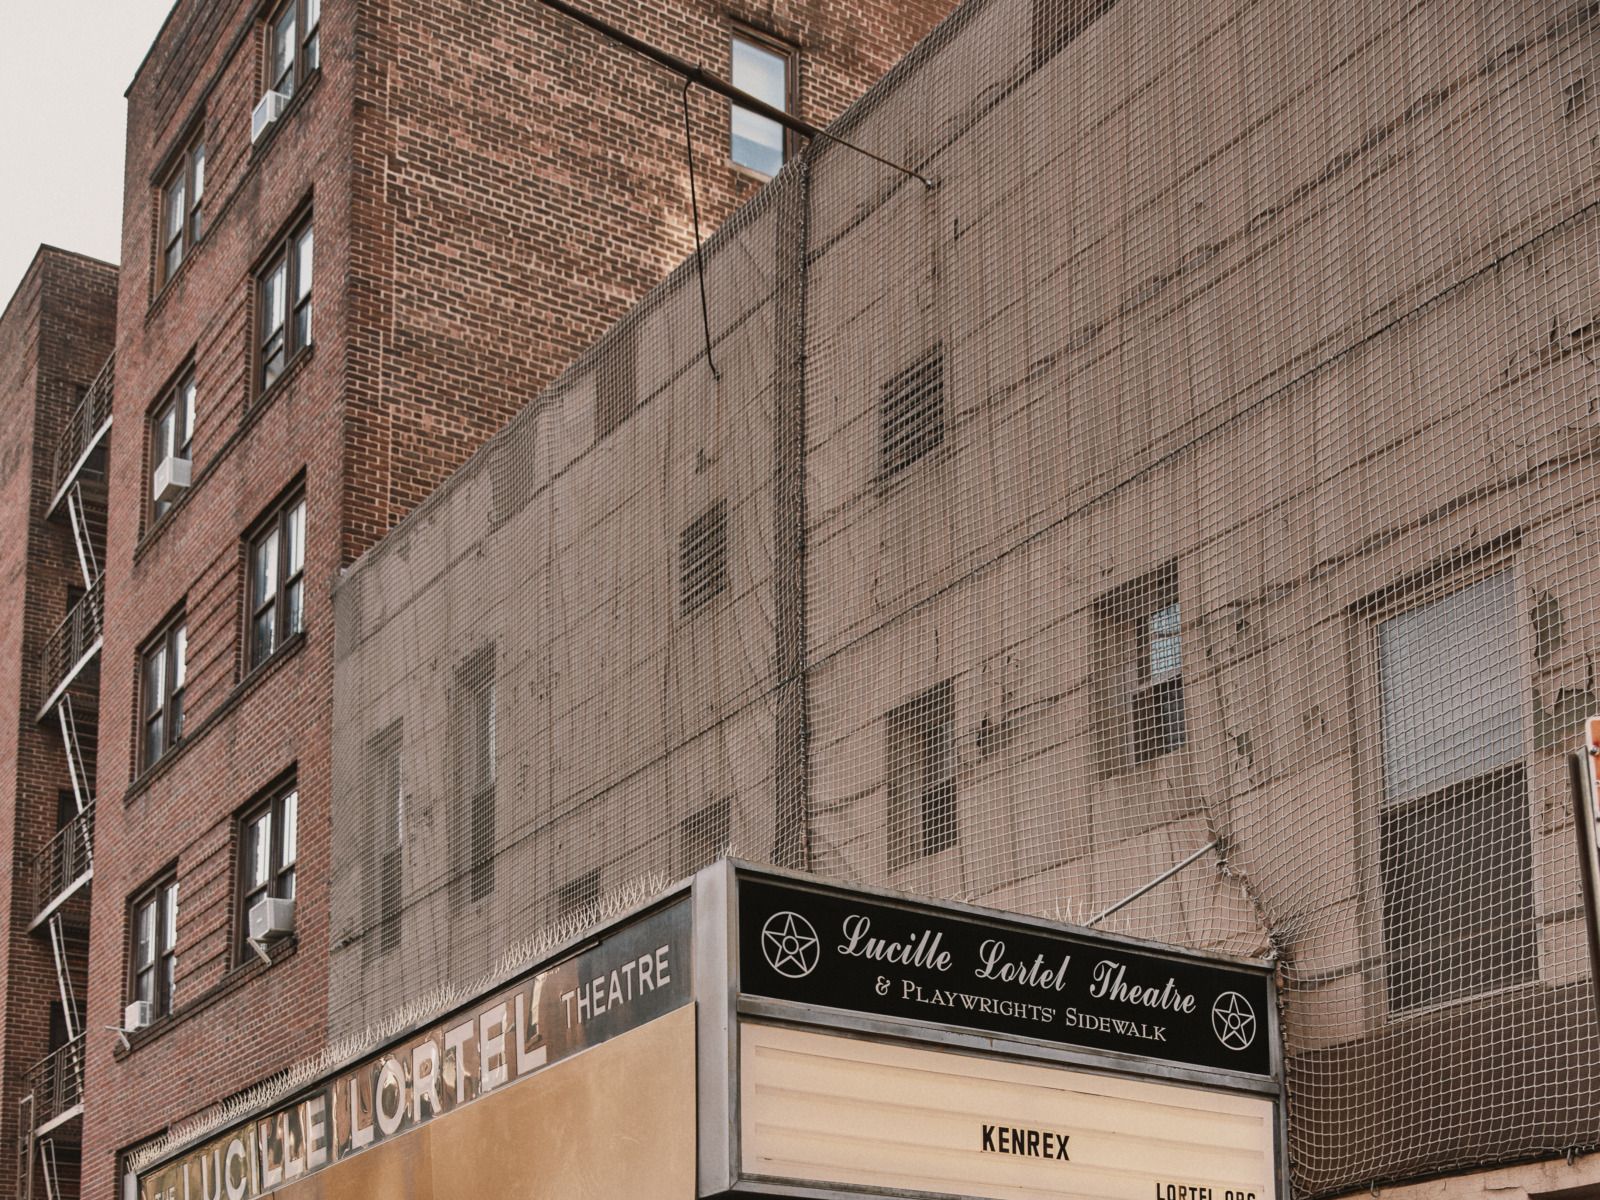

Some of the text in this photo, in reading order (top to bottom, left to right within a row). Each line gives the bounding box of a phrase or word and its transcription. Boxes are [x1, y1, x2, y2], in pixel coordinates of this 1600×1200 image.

[838, 914, 1196, 1014] Lucille Lortel Theatre
[350, 992, 547, 1149] LORTEL
[561, 944, 671, 1029] THEATRE
[875, 975, 1168, 1042] & PLAYWRIGHTS' SIDEWALK
[982, 1124, 1070, 1161] KENREX
